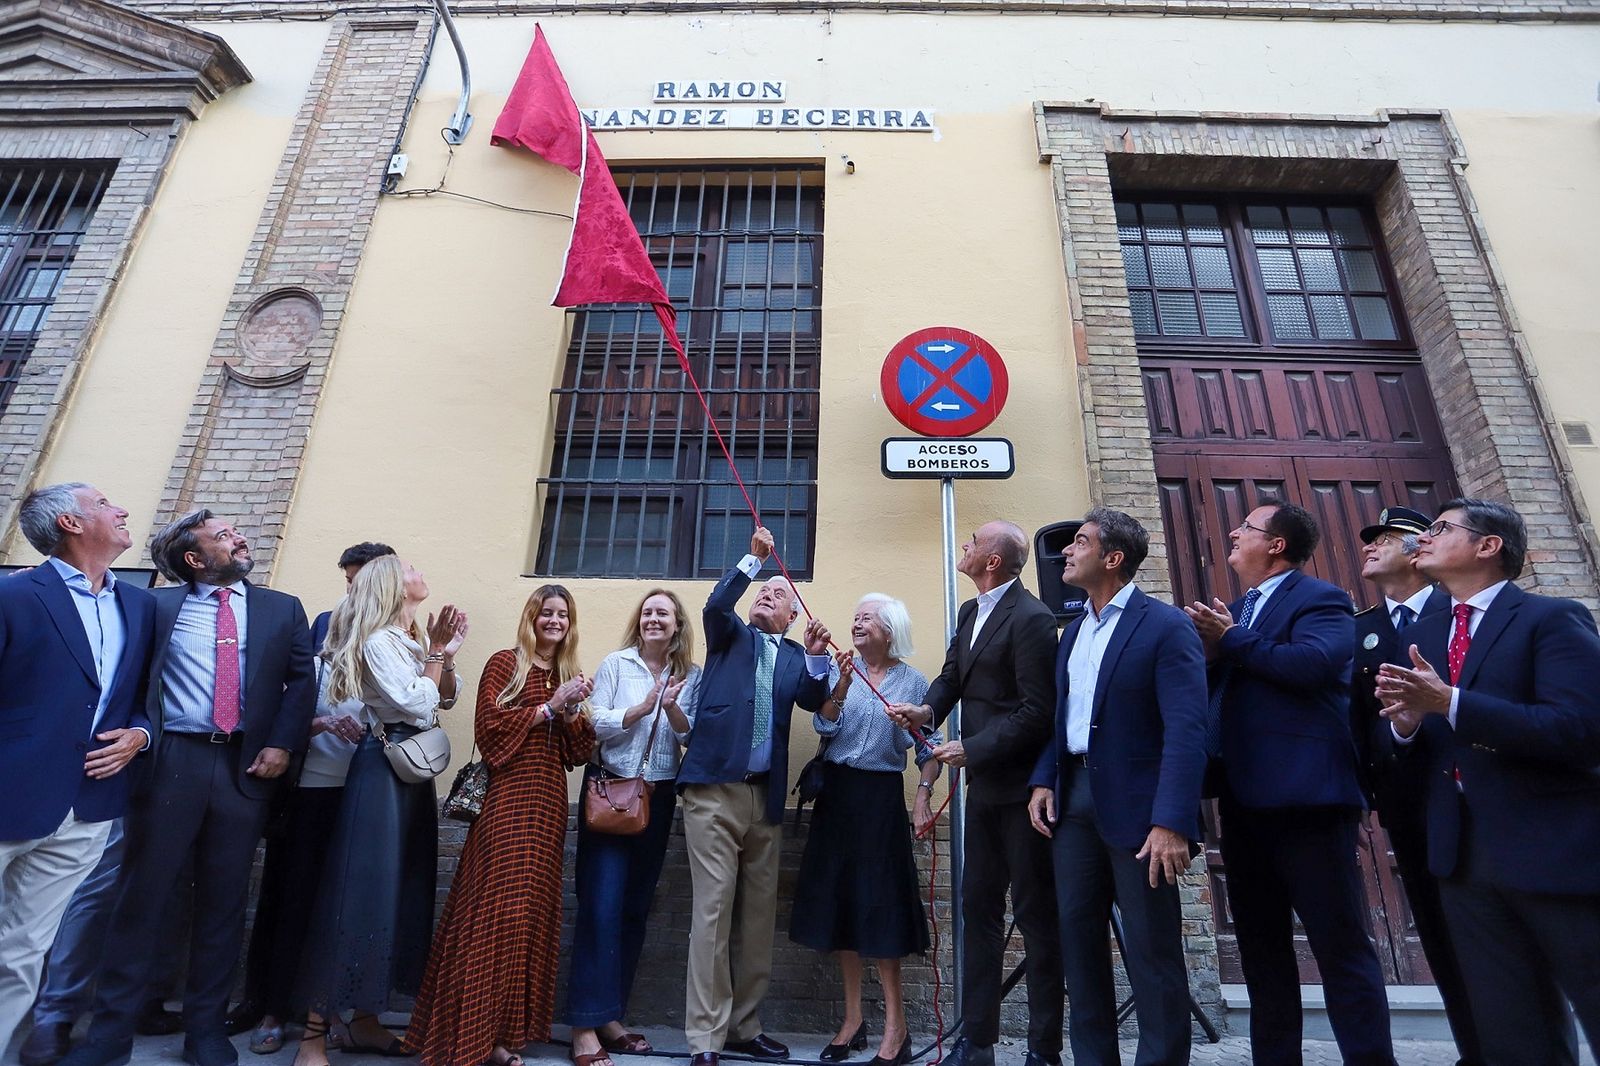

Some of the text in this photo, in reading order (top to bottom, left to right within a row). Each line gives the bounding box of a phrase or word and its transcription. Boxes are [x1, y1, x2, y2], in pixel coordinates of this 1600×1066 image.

[656, 82, 782, 98] RAMON
[756, 109, 931, 127] BECERRA
[918, 444, 978, 455] ACCESO
[907, 459, 990, 469] BOMBEROS
